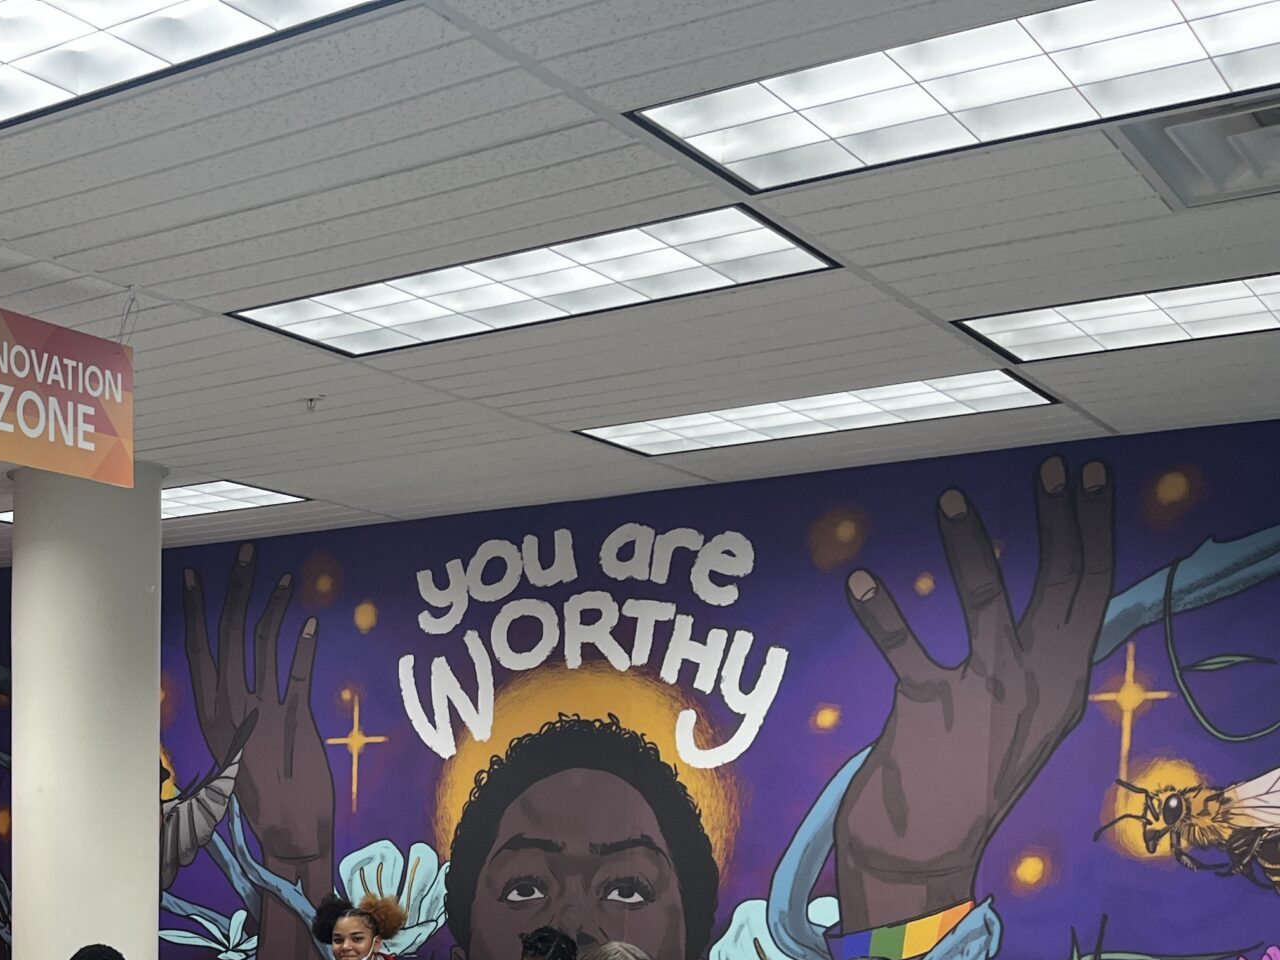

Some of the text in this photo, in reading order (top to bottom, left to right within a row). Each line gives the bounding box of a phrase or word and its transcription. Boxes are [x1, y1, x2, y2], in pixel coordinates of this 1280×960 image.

[416, 522, 755, 635] you are
[398, 590, 789, 769] WORTHY
